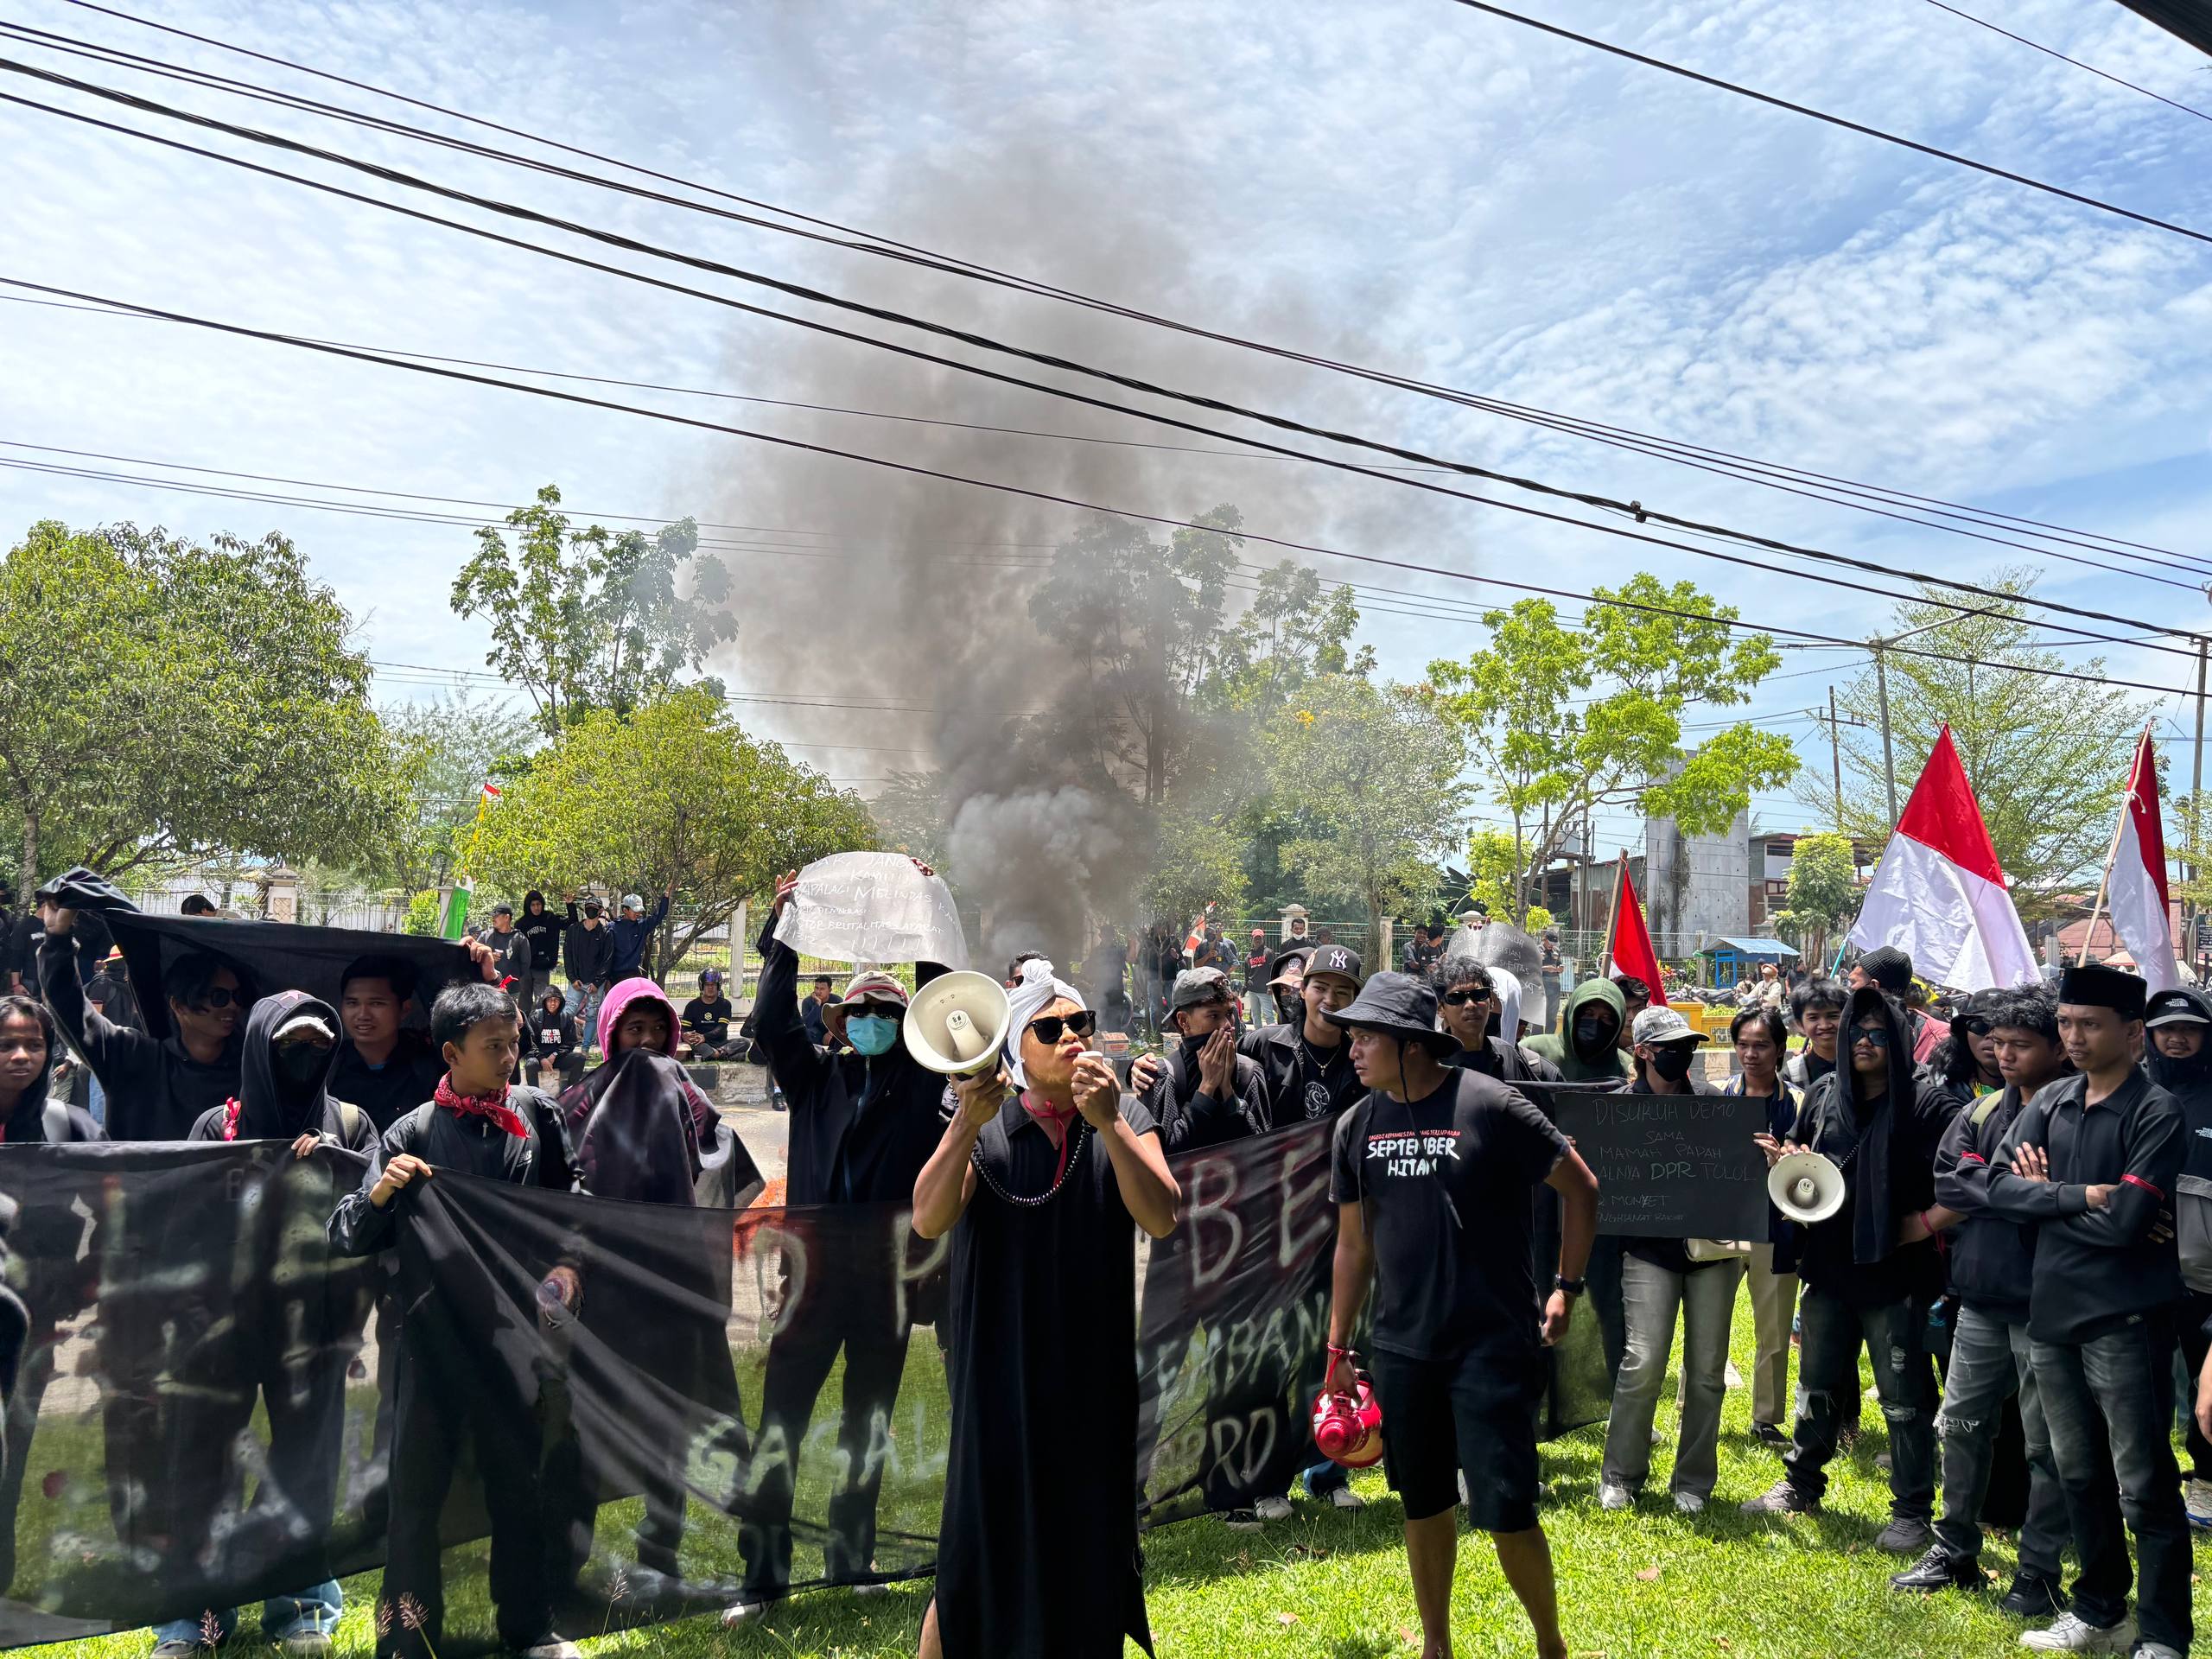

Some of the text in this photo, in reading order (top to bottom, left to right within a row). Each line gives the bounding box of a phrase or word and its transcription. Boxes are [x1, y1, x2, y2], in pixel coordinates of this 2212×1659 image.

[1592, 1098, 1735, 1126] DISURUH DEMO
[1643, 1130, 1685, 1145] SAMA
[1650, 1161, 1696, 1180] DPR
[1700, 1162, 1757, 1182] TOLOL
